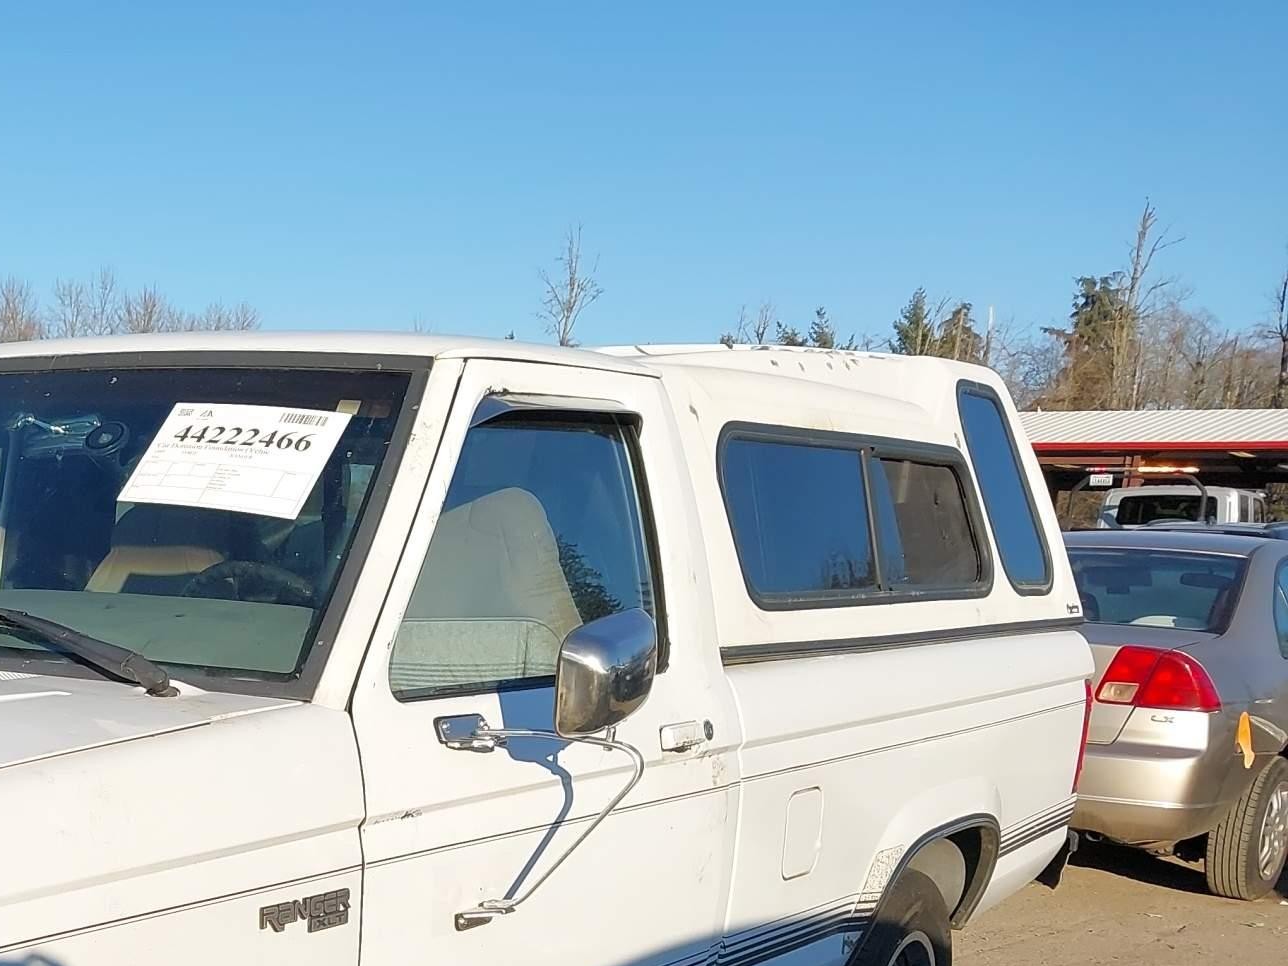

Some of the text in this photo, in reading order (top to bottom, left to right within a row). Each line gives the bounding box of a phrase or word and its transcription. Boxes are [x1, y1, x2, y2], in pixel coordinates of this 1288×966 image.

[174, 424, 317, 452] 44222466
[259, 888, 351, 933] RANGER
[313, 913, 346, 931] XLT
